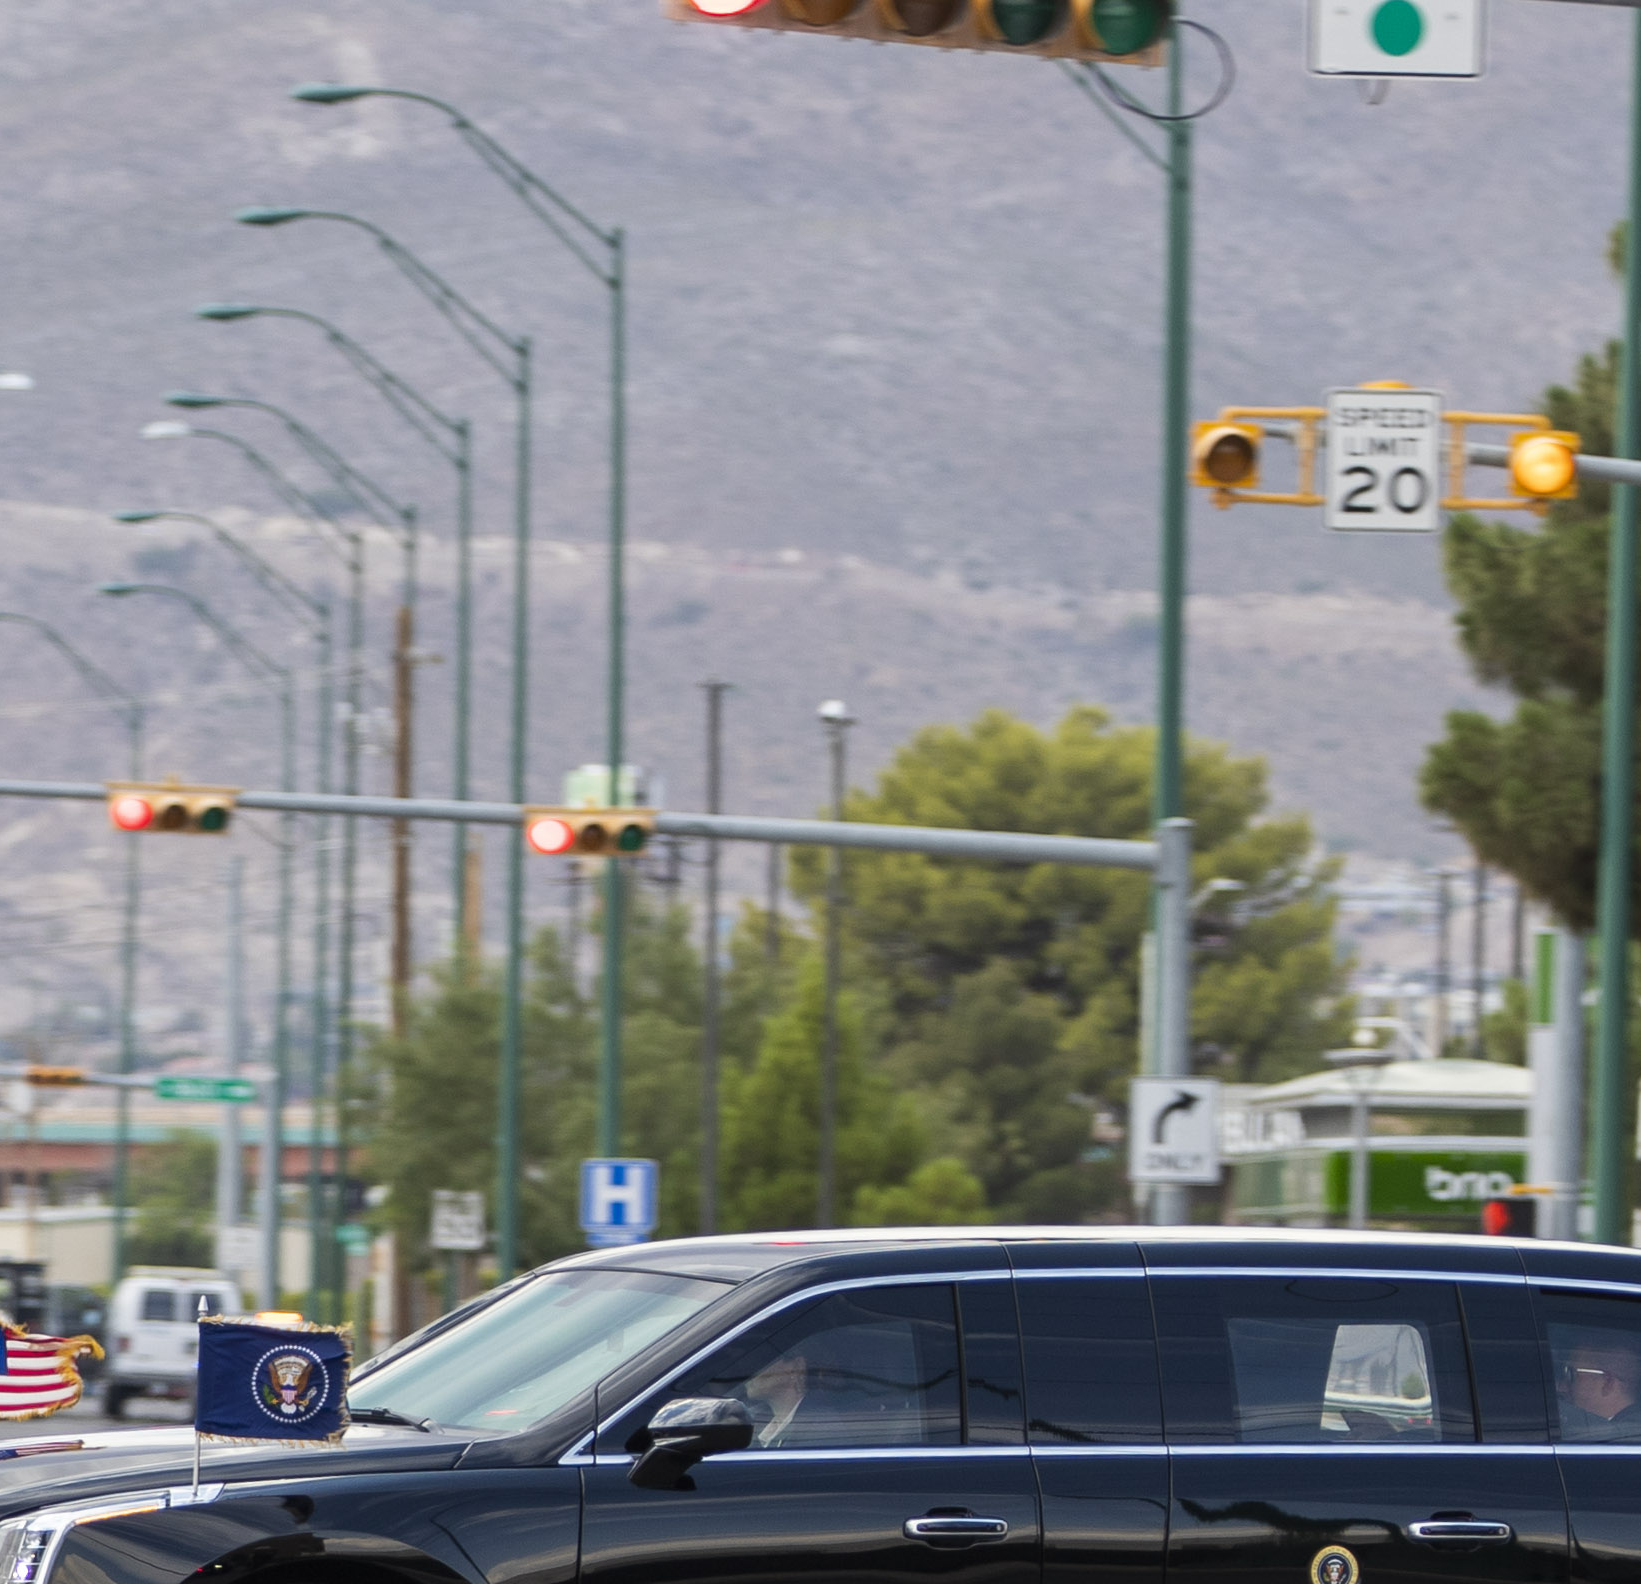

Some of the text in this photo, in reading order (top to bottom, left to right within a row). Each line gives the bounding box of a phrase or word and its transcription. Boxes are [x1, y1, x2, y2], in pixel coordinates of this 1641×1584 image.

[1339, 407, 1430, 429] SPEED
[1345, 436, 1418, 457] LIMIT
[1340, 465, 1429, 513] 20
[592, 1165, 643, 1224] H
